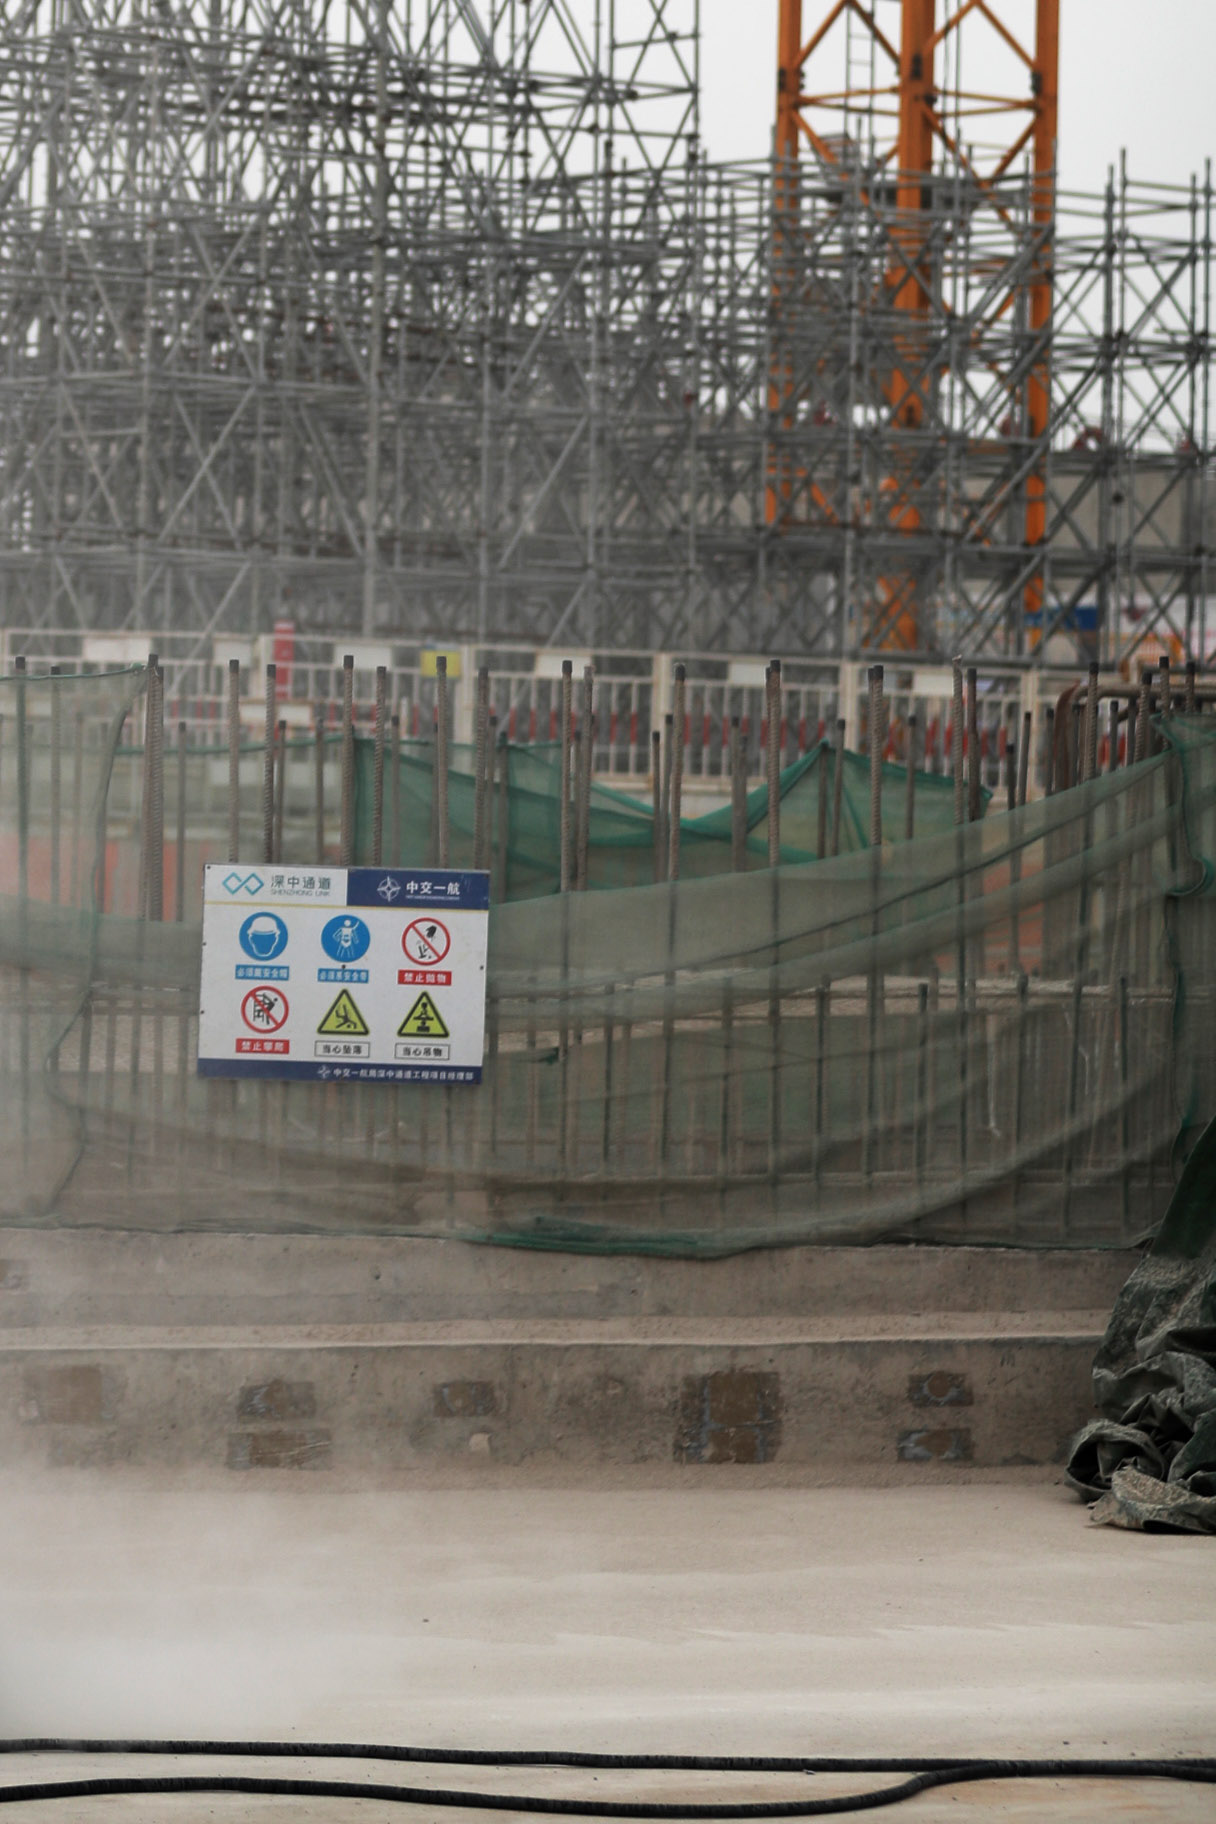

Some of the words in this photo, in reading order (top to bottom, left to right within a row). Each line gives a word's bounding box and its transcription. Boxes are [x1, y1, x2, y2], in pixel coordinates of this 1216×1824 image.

[270, 875, 331, 891] 深中通道
[406, 881, 461, 896] 中交一航
[322, 1044, 362, 1056] 当心坠落
[402, 1046, 443, 1058] 当心吊物
